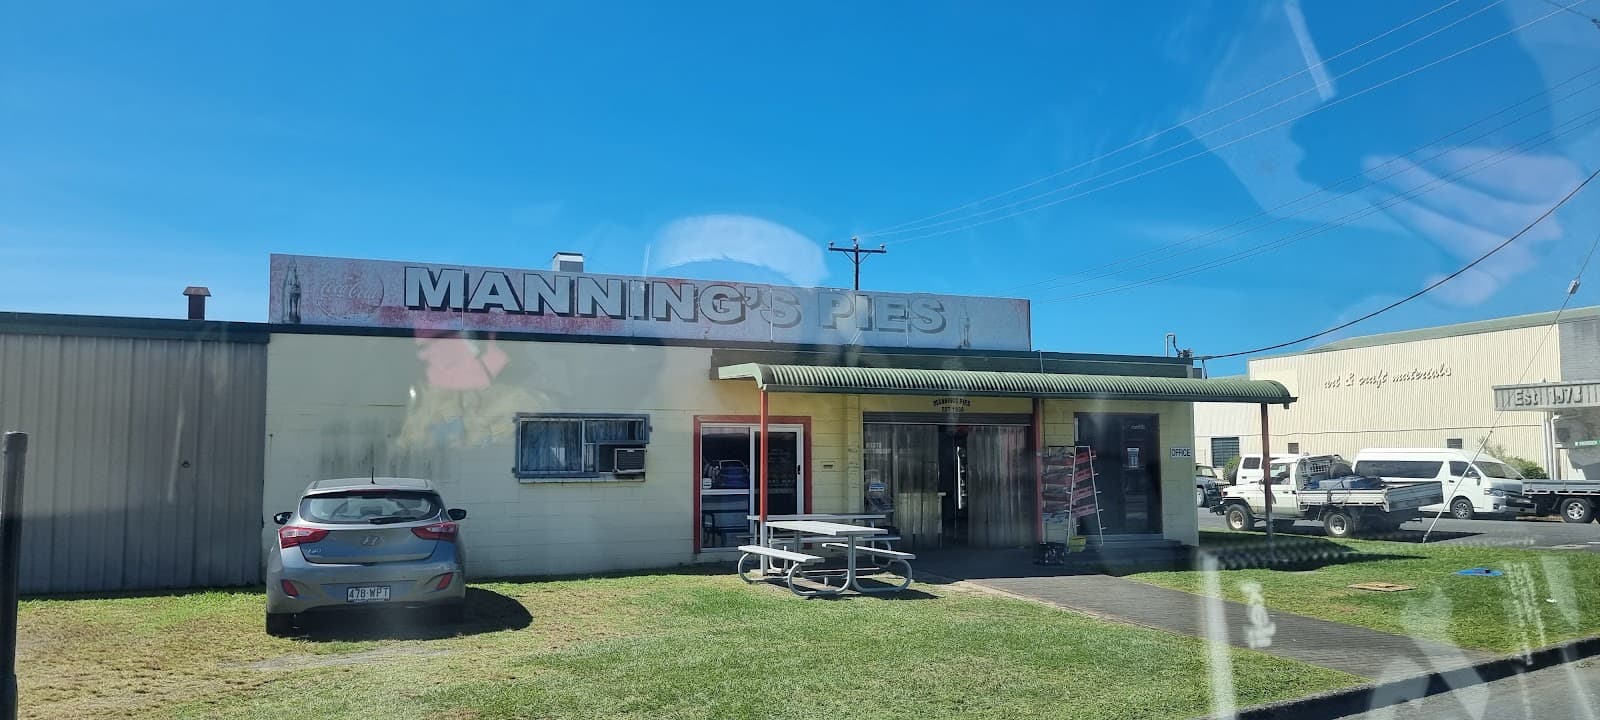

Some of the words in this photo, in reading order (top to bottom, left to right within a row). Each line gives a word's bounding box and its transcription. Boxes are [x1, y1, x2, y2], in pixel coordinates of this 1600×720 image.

[405, 266, 802, 329] MANNING'S
[818, 292, 947, 333] PIES
[1359, 369, 1389, 388] craft
[1392, 363, 1453, 382] materials
[1171, 448, 1191, 456] OFFICE
